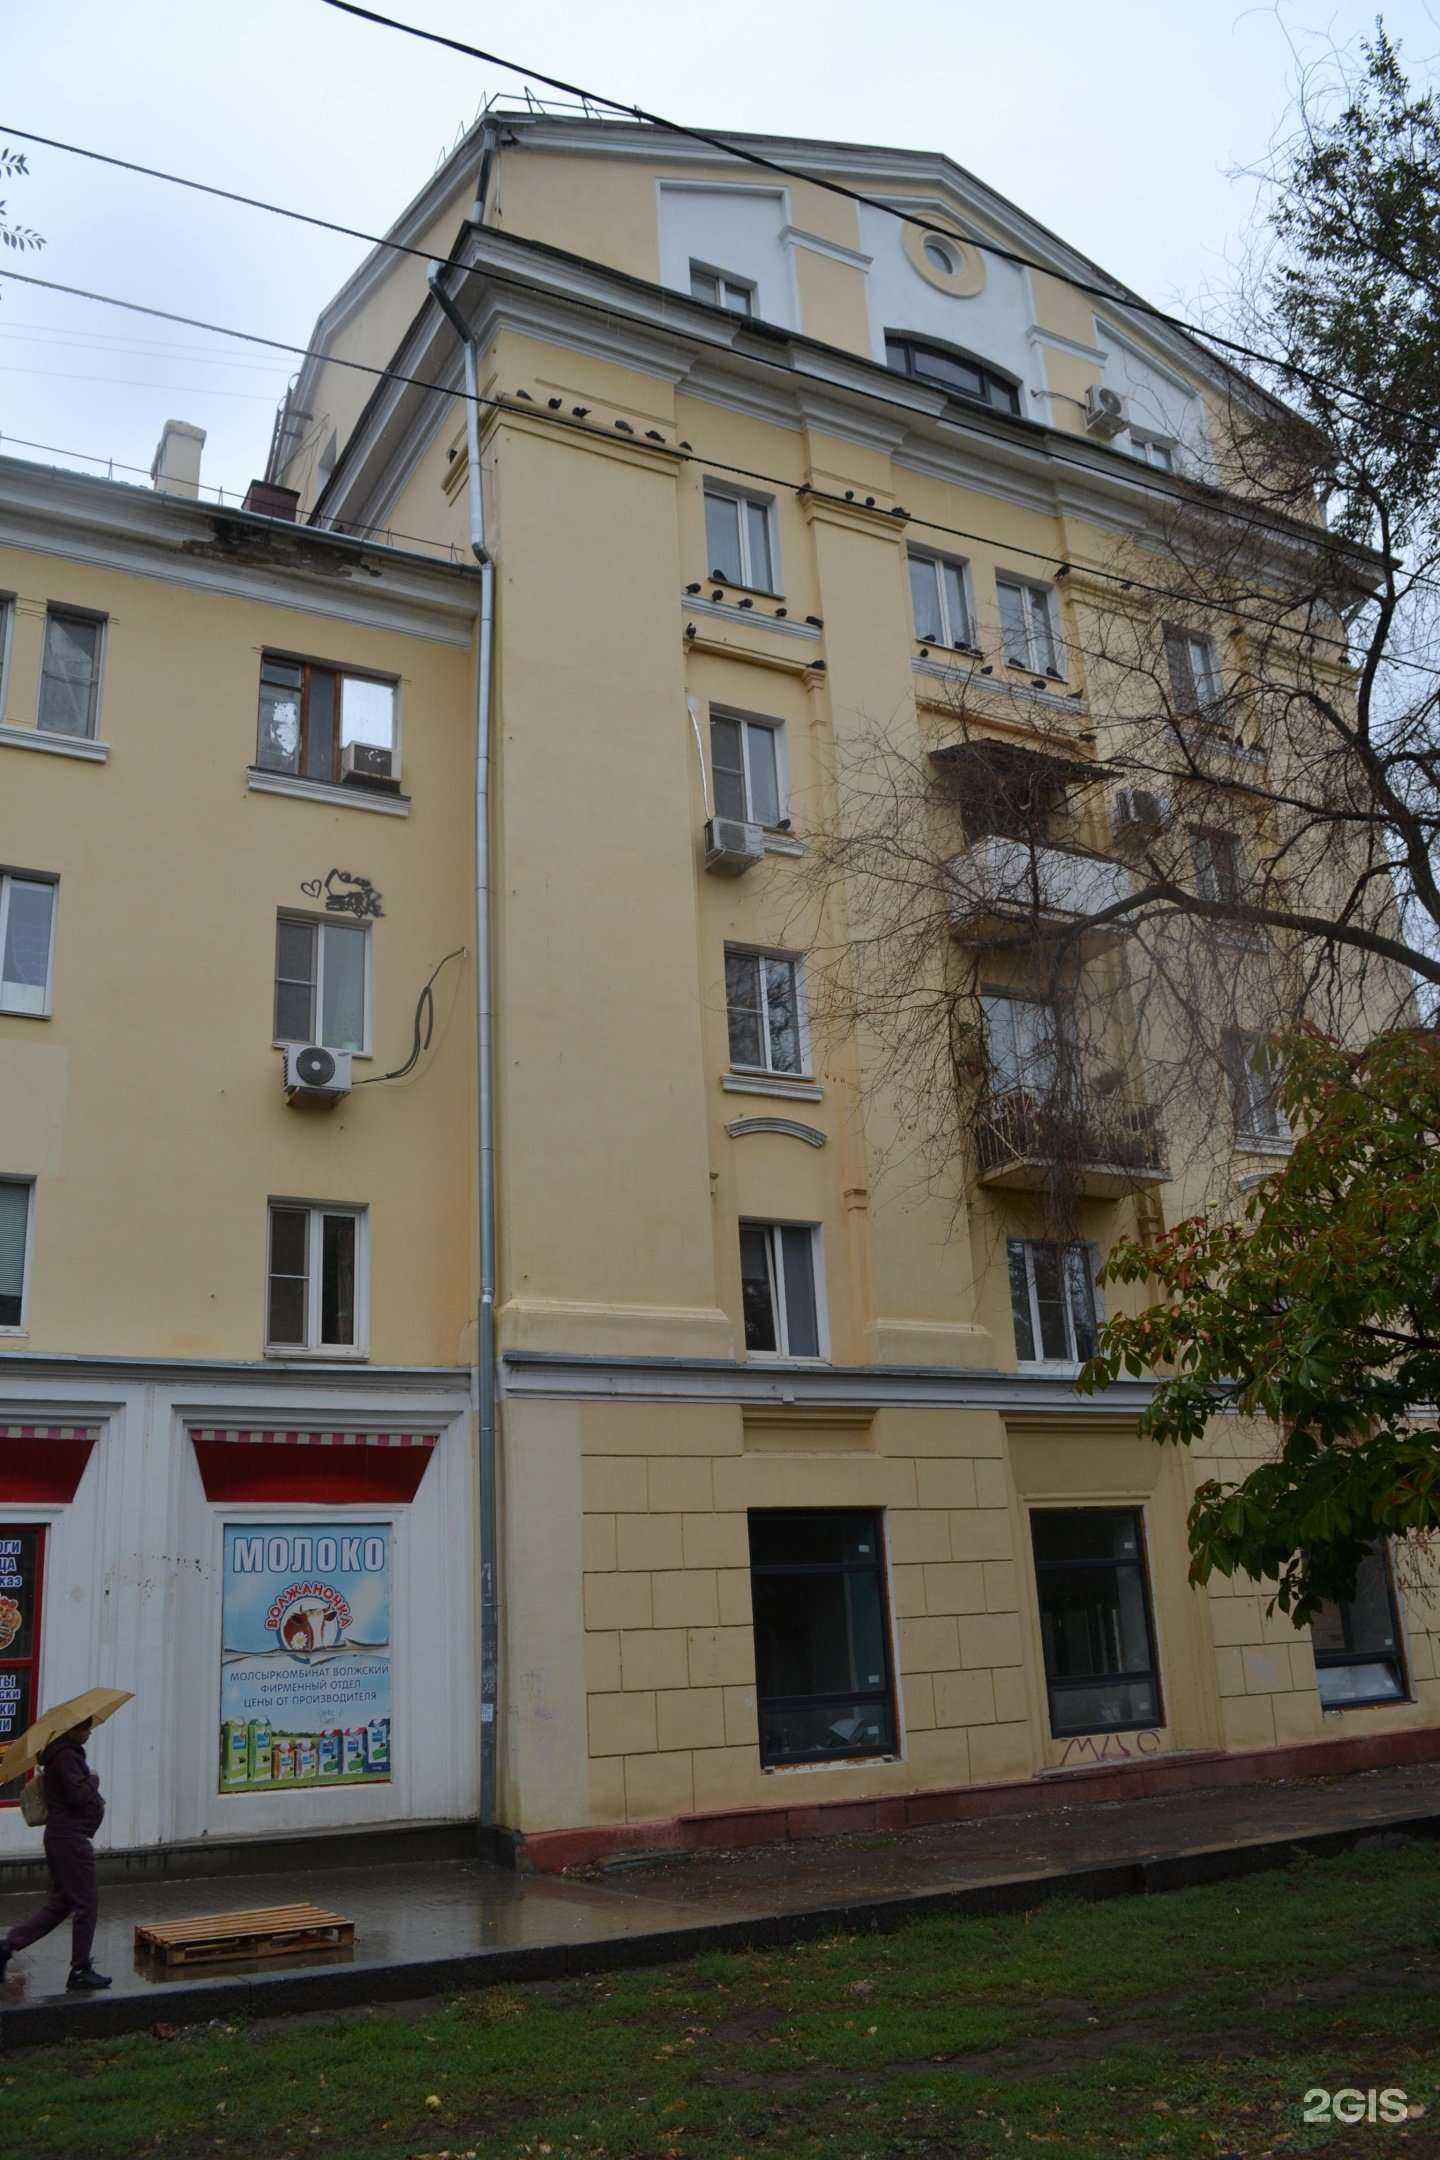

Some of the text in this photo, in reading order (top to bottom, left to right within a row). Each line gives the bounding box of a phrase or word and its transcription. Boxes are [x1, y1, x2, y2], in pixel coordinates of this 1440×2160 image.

[233, 1536, 385, 1573] МОЛОКО
[265, 1580, 353, 1632] ВОЛЖАНОЧКА
[230, 1665, 389, 1681] МОЛСЫРКОМБИНАТ ВОЛЖСКИЙ
[260, 1679, 361, 1693] ФИРМЕННЫЙ ОТДЕЛ
[244, 1692, 377, 1708] ЦЕНЫ ОТ ПРОИЗВОДИТЕЛЯ
